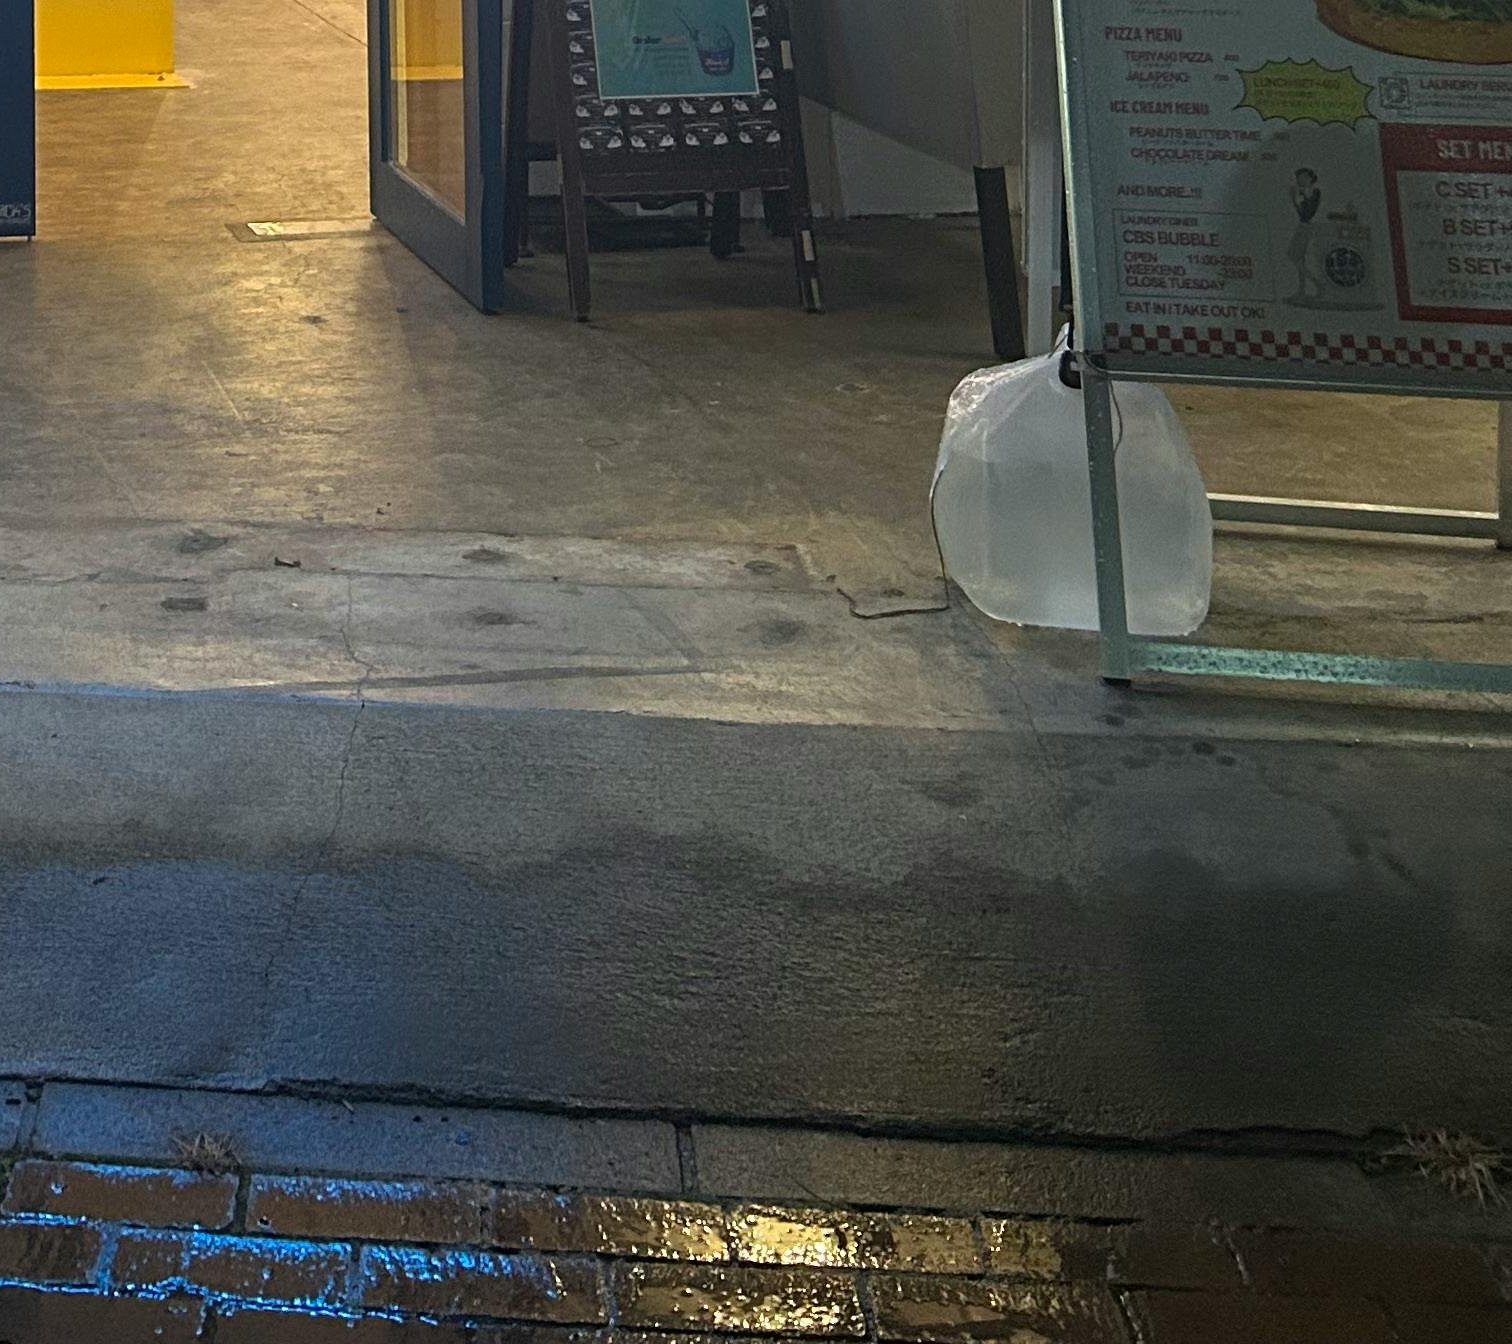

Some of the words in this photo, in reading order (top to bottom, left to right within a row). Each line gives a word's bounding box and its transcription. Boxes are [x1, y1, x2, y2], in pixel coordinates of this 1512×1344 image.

[1105, 26, 1141, 41] PIZZA
[1145, 27, 1182, 42] MENU
[1179, 52, 1213, 62] PIZZA
[1420, 79, 1478, 90] LAUNDRY
[1110, 100, 1129, 113] ICE
[1132, 101, 1172, 114] CREAM
[1175, 102, 1209, 115] MENU
[1129, 127, 1183, 139] PEANUTS
[1186, 128, 1232, 140] BUTTER
[1233, 130, 1261, 141] TIME
[1131, 148, 1204, 161] CHOCOLATE
[1206, 150, 1249, 161] DREAM
[1437, 140, 1475, 160] SET
[1117, 185, 1145, 196] AND
[1454, 181, 1493, 199] SET
[1443, 218, 1457, 235] B
[1122, 230, 1156, 244] CBS
[1157, 232, 1220, 247] BUBBLE
[1124, 252, 1158, 263] OPEN
[1124, 264, 1185, 276] WEEKEND
[1447, 257, 1460, 274] S
[1125, 278, 1166, 288] CLOSE
[1167, 278, 1225, 290] TUESDAY
[1126, 302, 1151, 313] EAT
[1152, 303, 1167, 315] IN
[1174, 304, 1208, 317] TAKE
[1210, 305, 1238, 318] OUT
